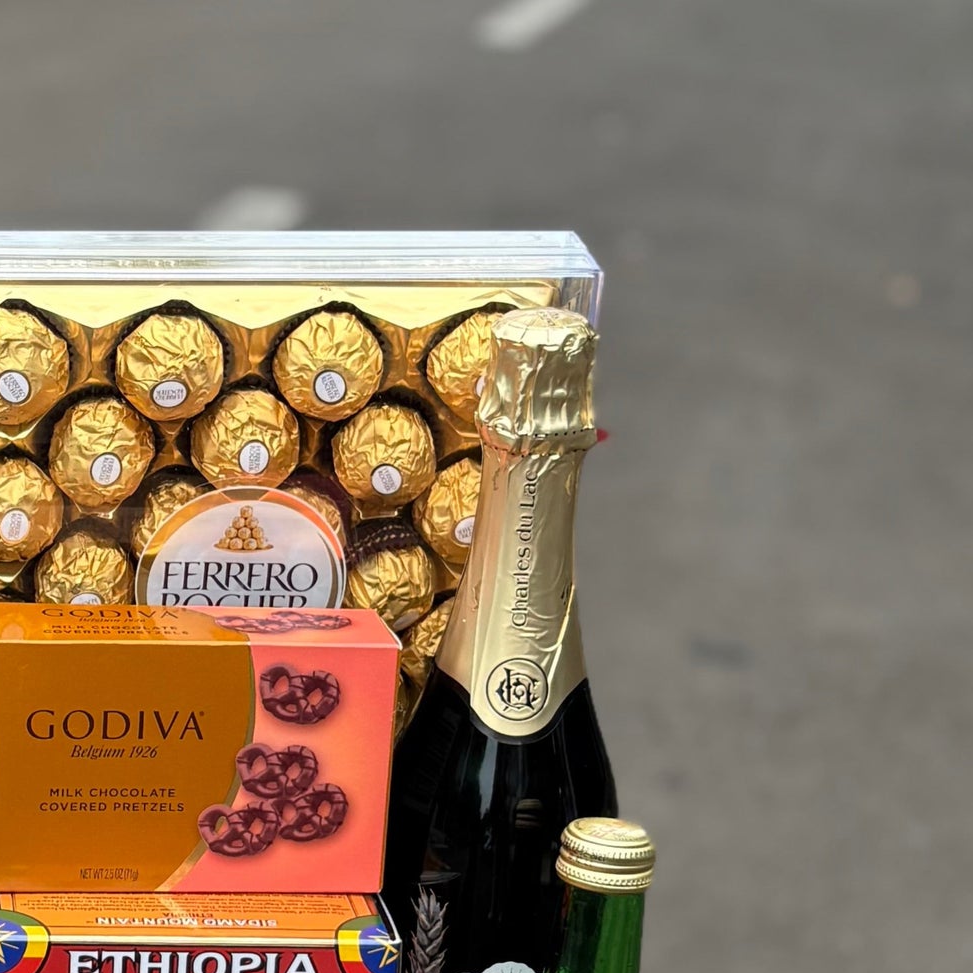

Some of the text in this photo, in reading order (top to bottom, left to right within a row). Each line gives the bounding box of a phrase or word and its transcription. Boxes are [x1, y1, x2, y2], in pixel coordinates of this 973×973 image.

[511, 470, 539, 628] Charles du Lac
[162, 561, 319, 592] FERRERO
[42, 608, 179, 619] GODIVA
[26, 709, 204, 741] GODIVA
[70, 744, 158, 760] Belgium 1926
[49, 787, 176, 799] MILK CHOCOLATE
[39, 801, 185, 813] COVERED PRETZELS
[97, 916, 277, 927] SIDAMO MOUNTAIN
